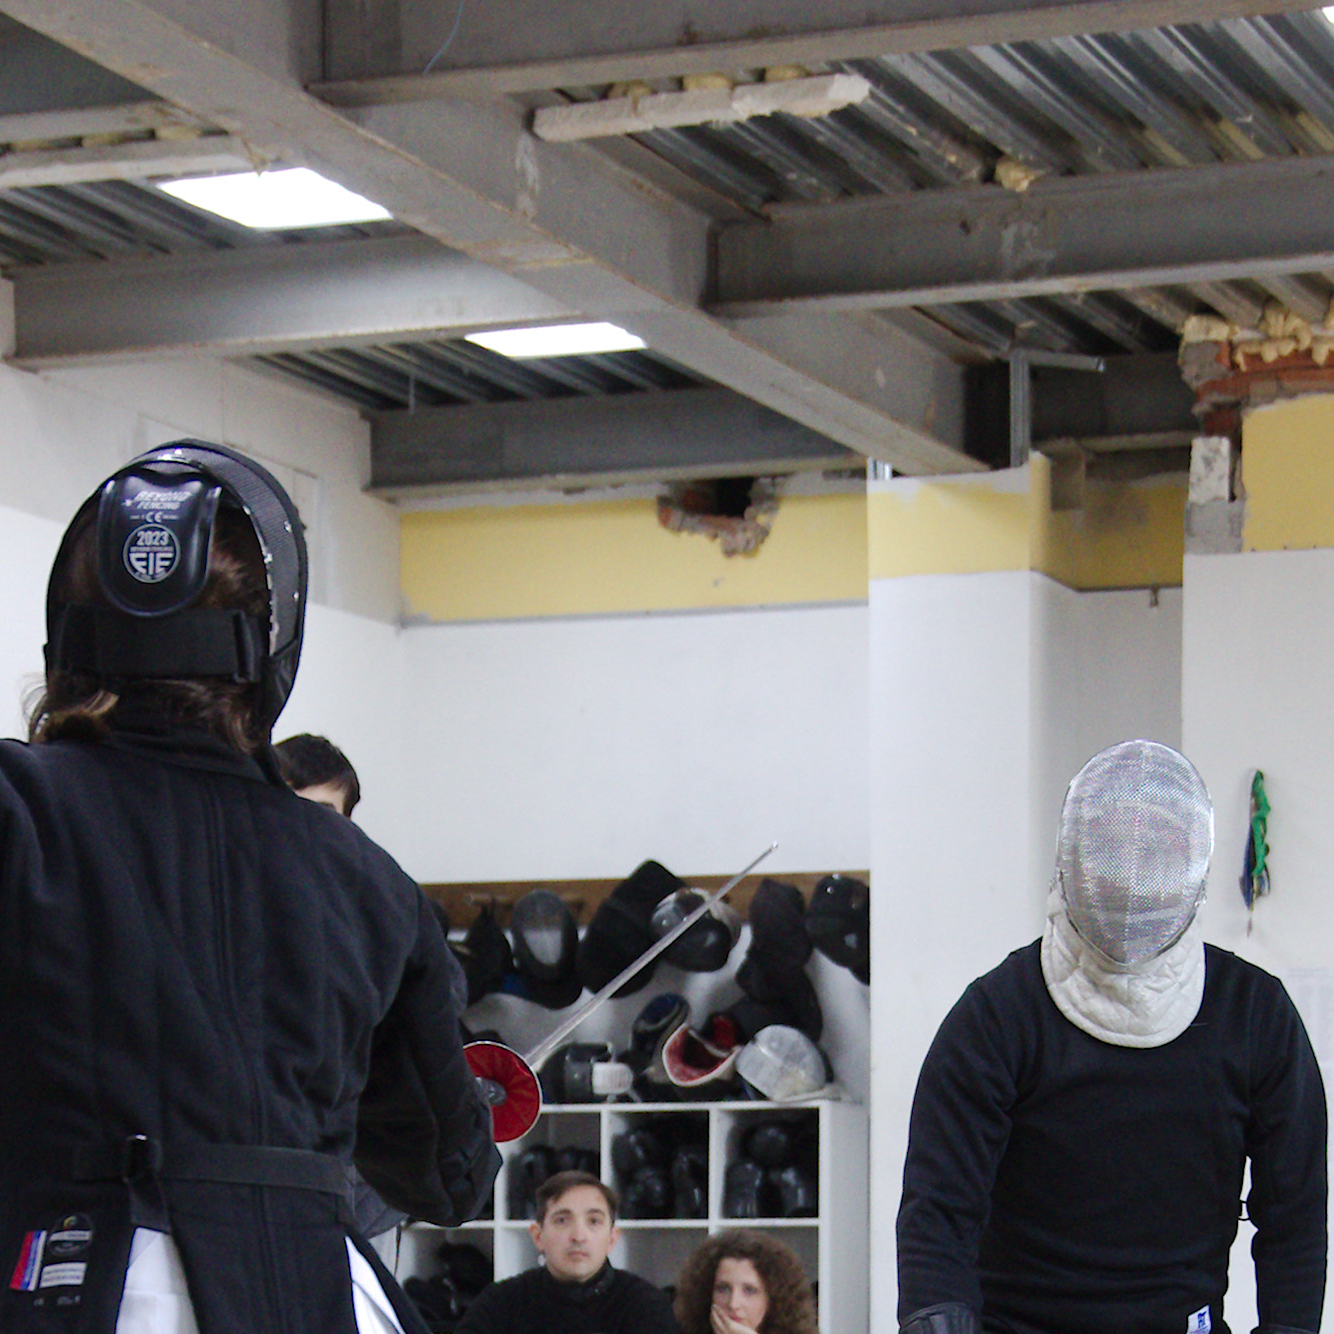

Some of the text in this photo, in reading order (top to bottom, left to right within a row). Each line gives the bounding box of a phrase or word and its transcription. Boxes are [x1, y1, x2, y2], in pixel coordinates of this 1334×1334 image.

[134, 491, 191, 502] BEYOND
[137, 501, 181, 510] FENCING
[145, 511, 163, 523] CE
[136, 530, 169, 546] 2023
